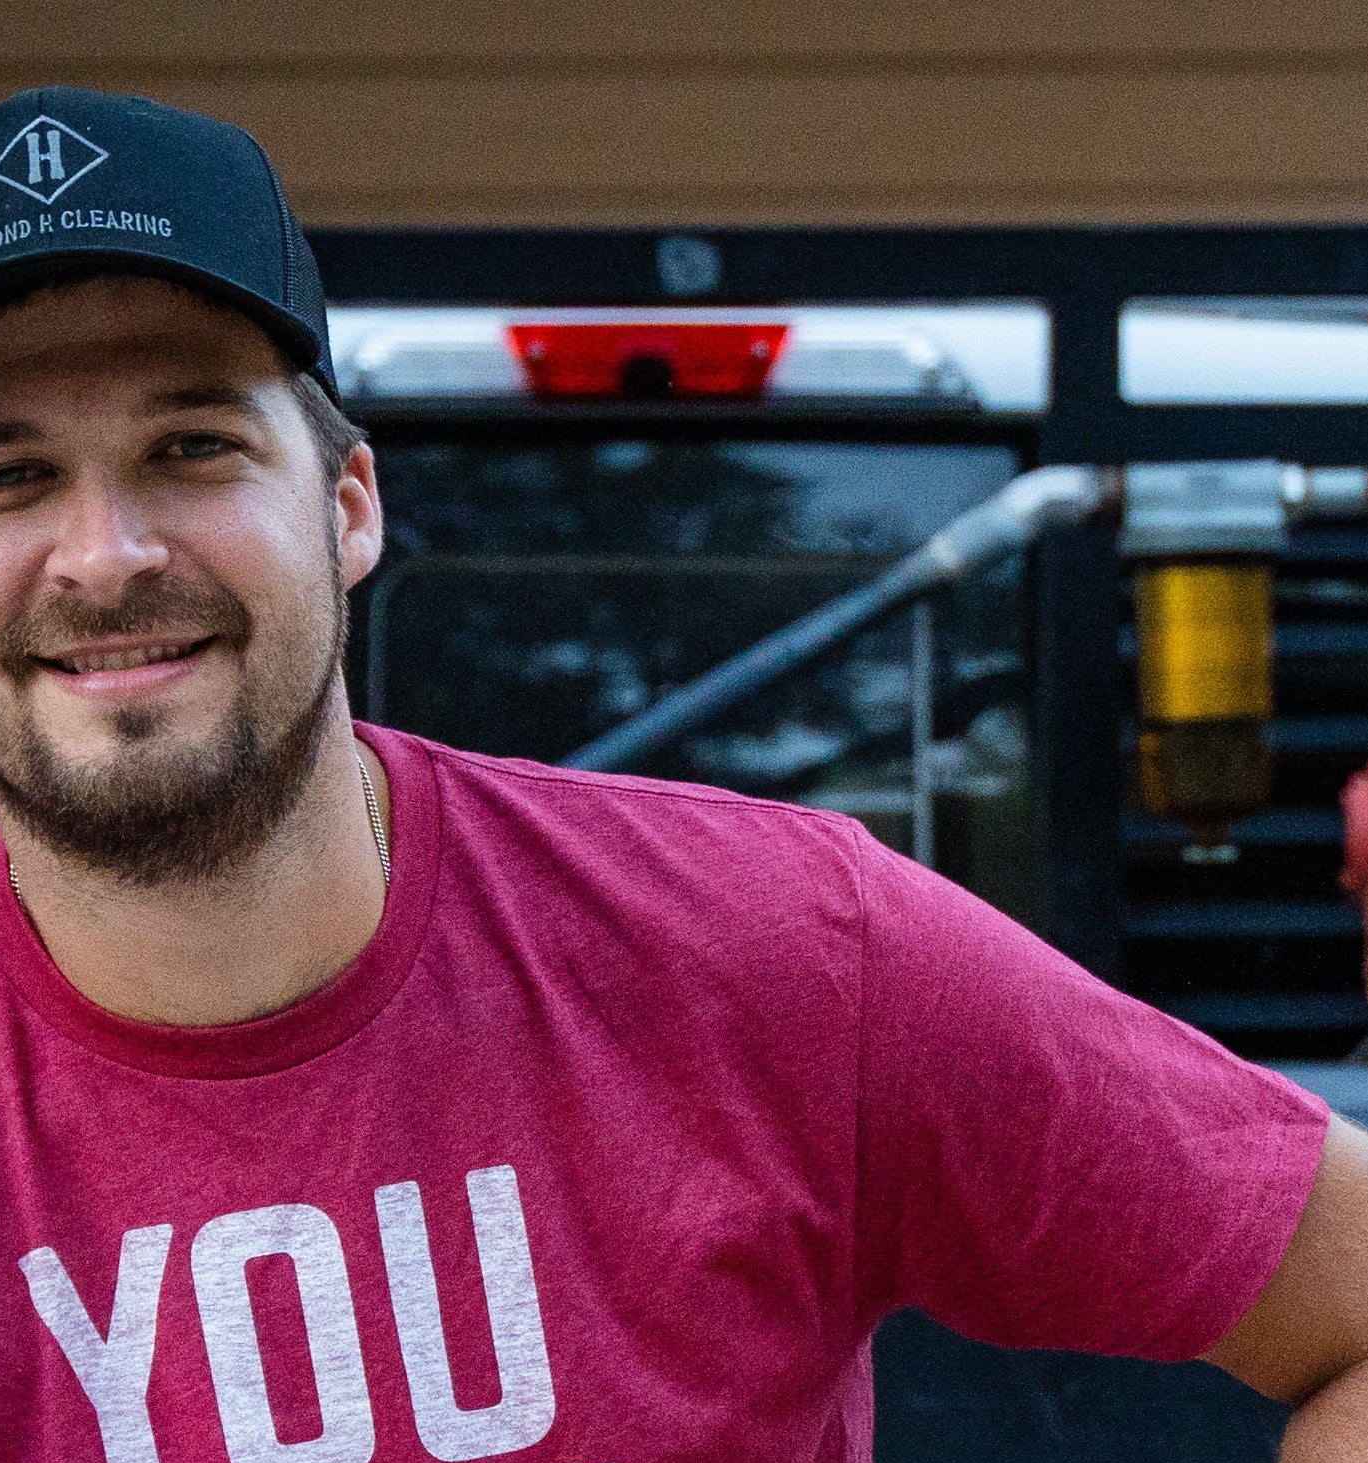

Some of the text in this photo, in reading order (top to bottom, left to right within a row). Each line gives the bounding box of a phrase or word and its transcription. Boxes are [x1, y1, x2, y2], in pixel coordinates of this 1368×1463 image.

[26, 129, 66, 185] H
[39, 213, 54, 234] H
[60, 208, 173, 238] CLEARING
